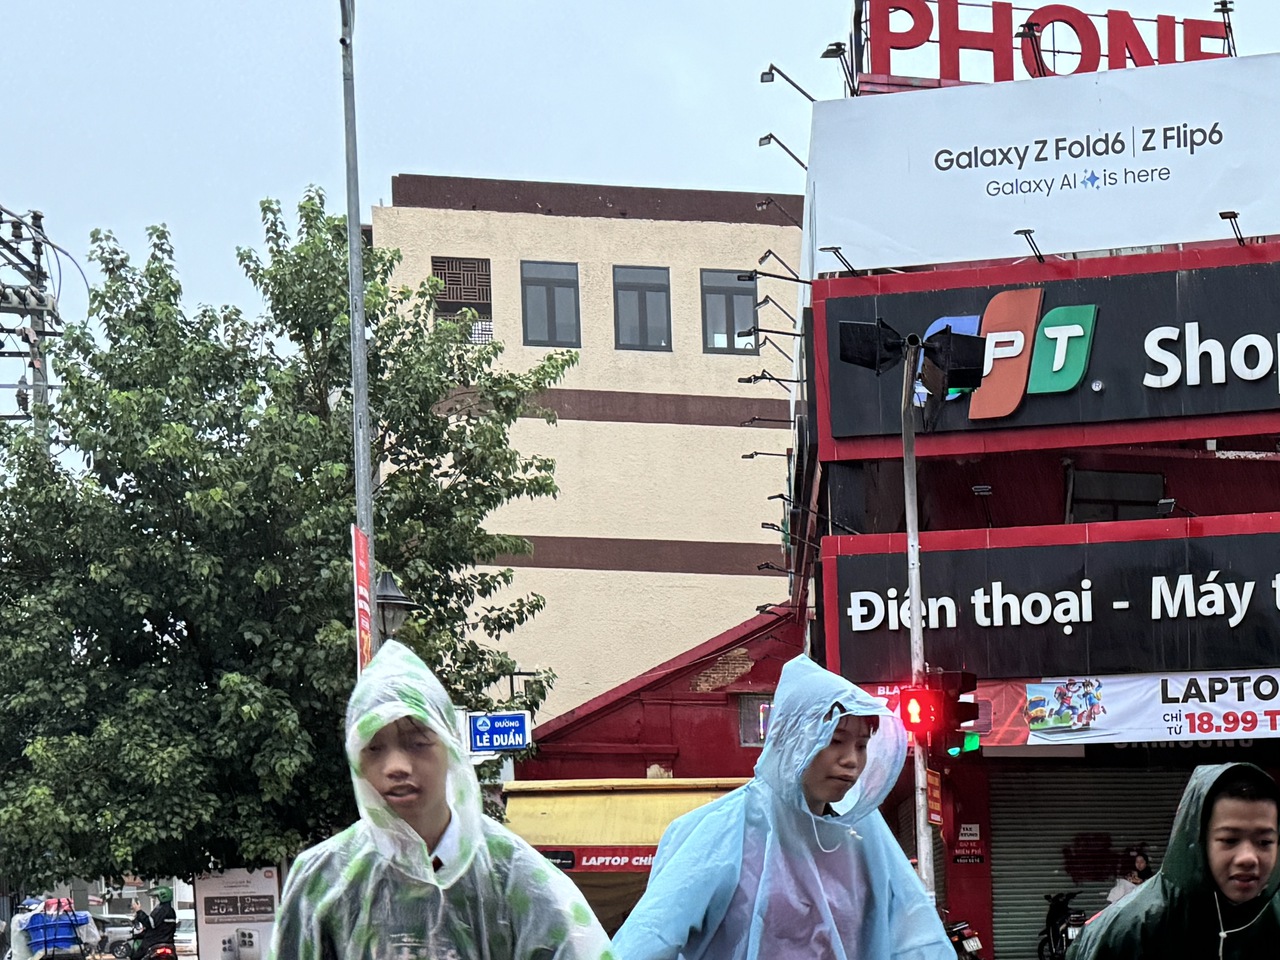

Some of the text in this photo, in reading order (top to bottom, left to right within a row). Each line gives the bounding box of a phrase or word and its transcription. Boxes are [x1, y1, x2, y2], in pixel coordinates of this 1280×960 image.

[869, 0, 1230, 83] PHONE
[934, 122, 1224, 172] Galaxy Z Fold6 Z Flip6
[986, 165, 1171, 198] Galaxy AI is here
[983, 325, 1084, 377] PT
[971, 578, 1092, 635] thoại
[1152, 570, 1256, 628] Máy
[1185, 711, 1258, 734] 18.99
[582, 856, 629, 866] LAPTOP
